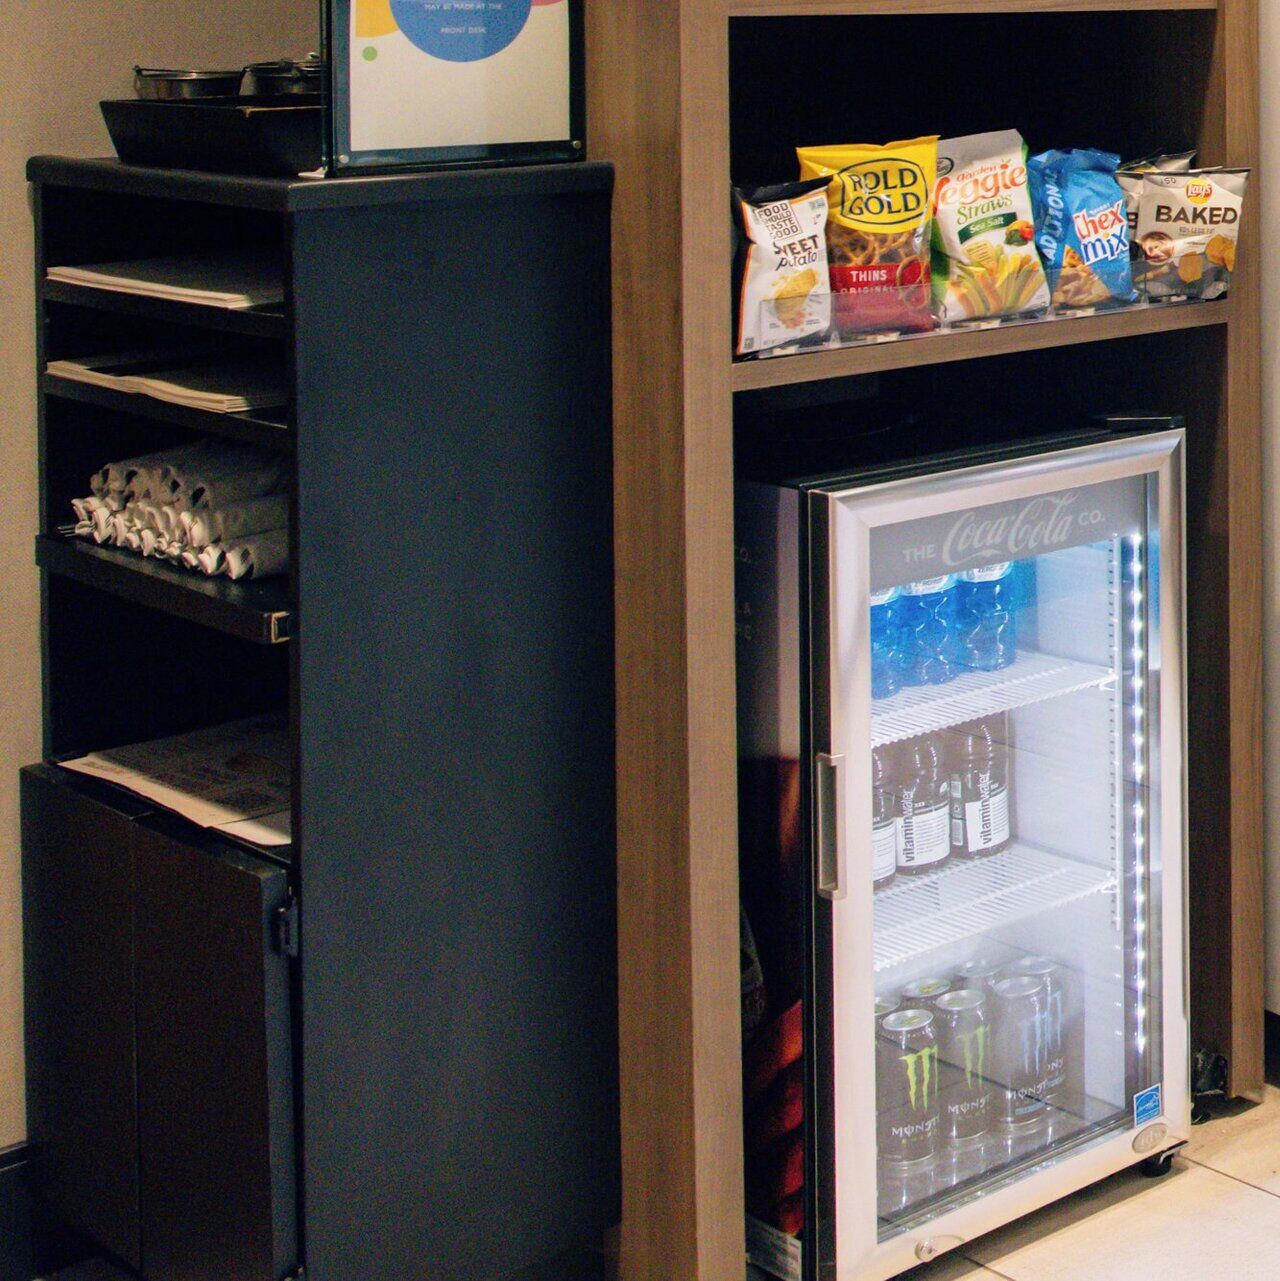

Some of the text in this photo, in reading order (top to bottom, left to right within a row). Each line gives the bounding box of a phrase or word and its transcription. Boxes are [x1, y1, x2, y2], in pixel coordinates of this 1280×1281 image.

[849, 168, 918, 194] ROLD
[933, 161, 1027, 217] Veggie
[757, 202, 789, 219] FOOD
[849, 192, 921, 217] GOLD
[957, 193, 1013, 226] Straws
[1155, 204, 1239, 226] BAKED
[766, 218, 795, 233] TASTE
[1074, 203, 1124, 239] Chex
[1081, 226, 1129, 263] mix
[850, 269, 888, 283] THINS
[902, 544, 937, 564] THE
[979, 770, 993, 846] vitaminwater
[902, 789, 916, 863] vitaminwater
